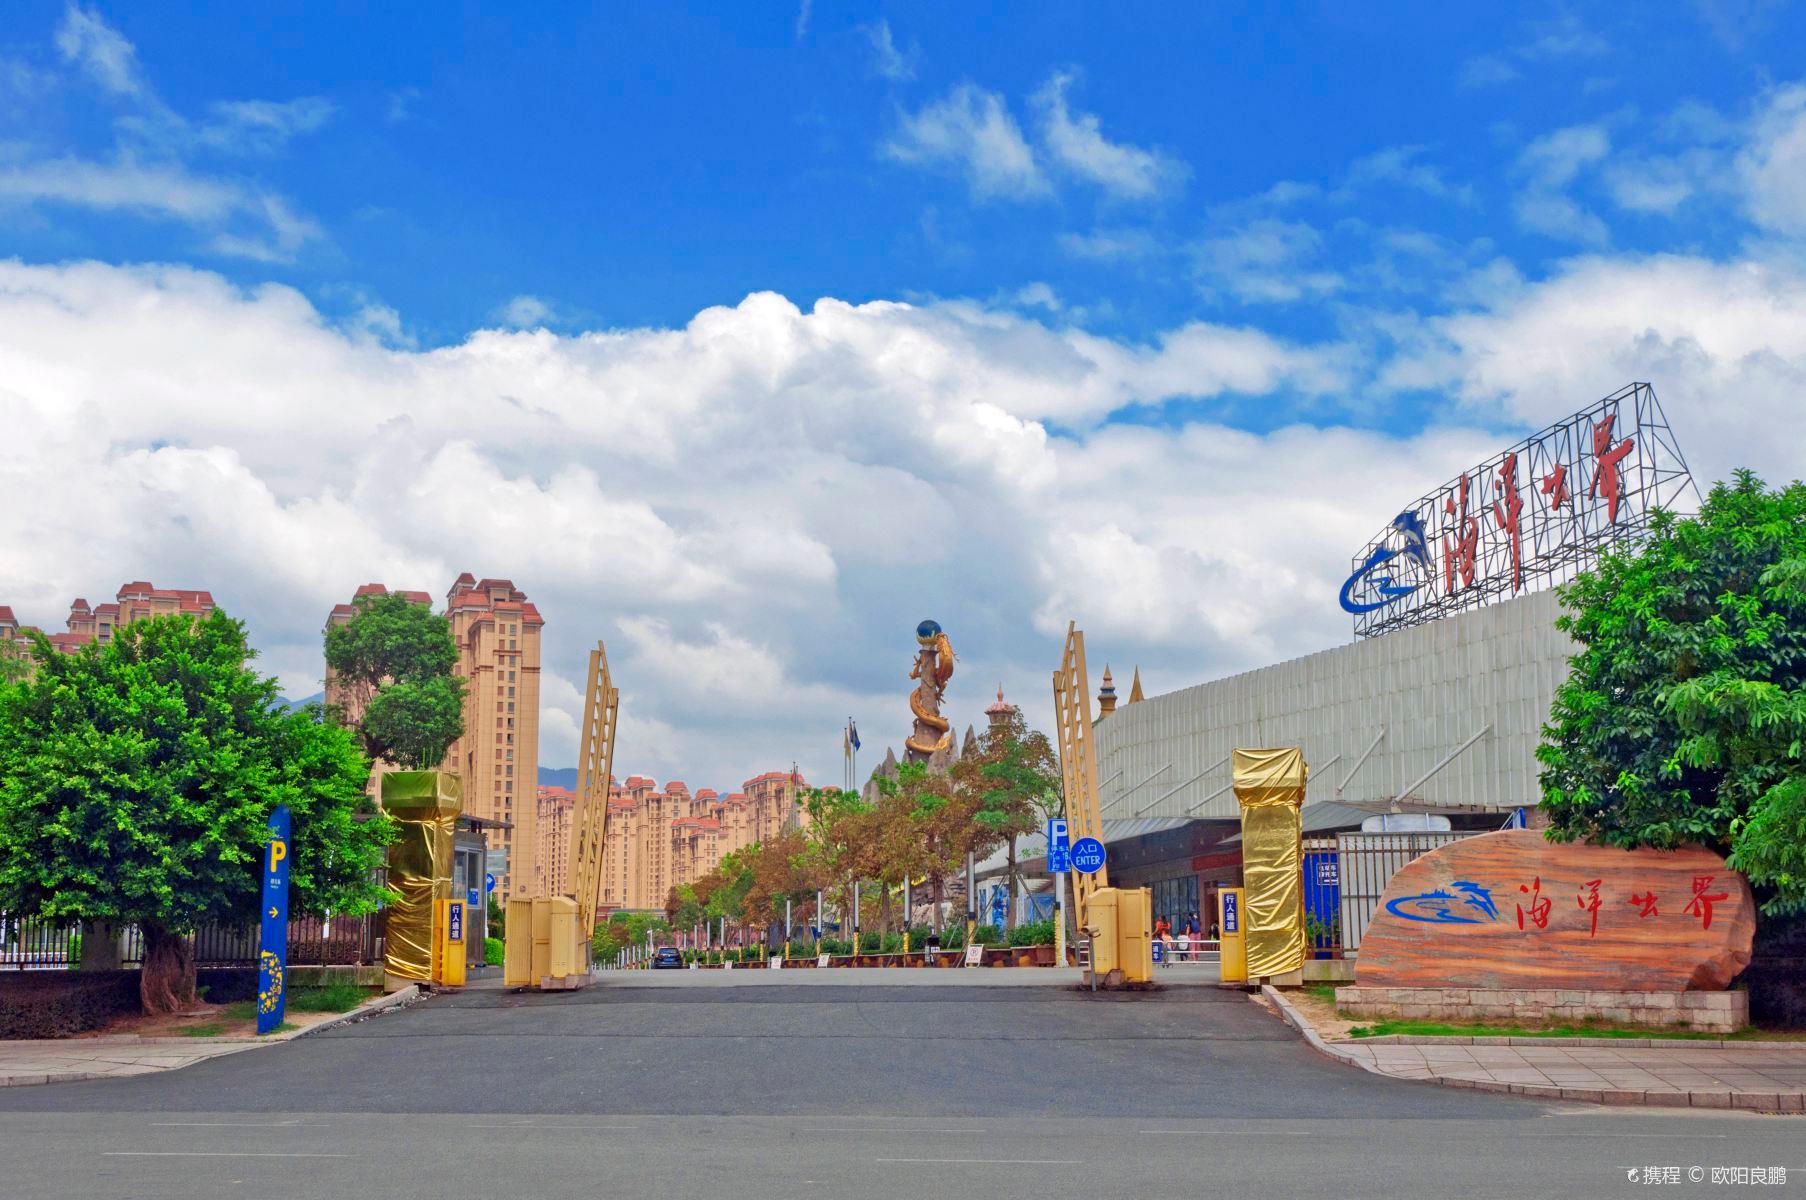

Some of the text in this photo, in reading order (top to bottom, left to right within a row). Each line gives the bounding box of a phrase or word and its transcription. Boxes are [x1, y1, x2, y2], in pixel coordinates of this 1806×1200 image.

[1444, 413, 1635, 594] 海洋世界
[1051, 820, 1068, 846] P
[1078, 844, 1097, 854] 入口
[270, 841, 287, 873] P
[1075, 855, 1101, 866] ENTER
[451, 905, 460, 939] 行人通道
[1225, 894, 1235, 930] 行人通道
[1516, 876, 1729, 938] 海洋世界
